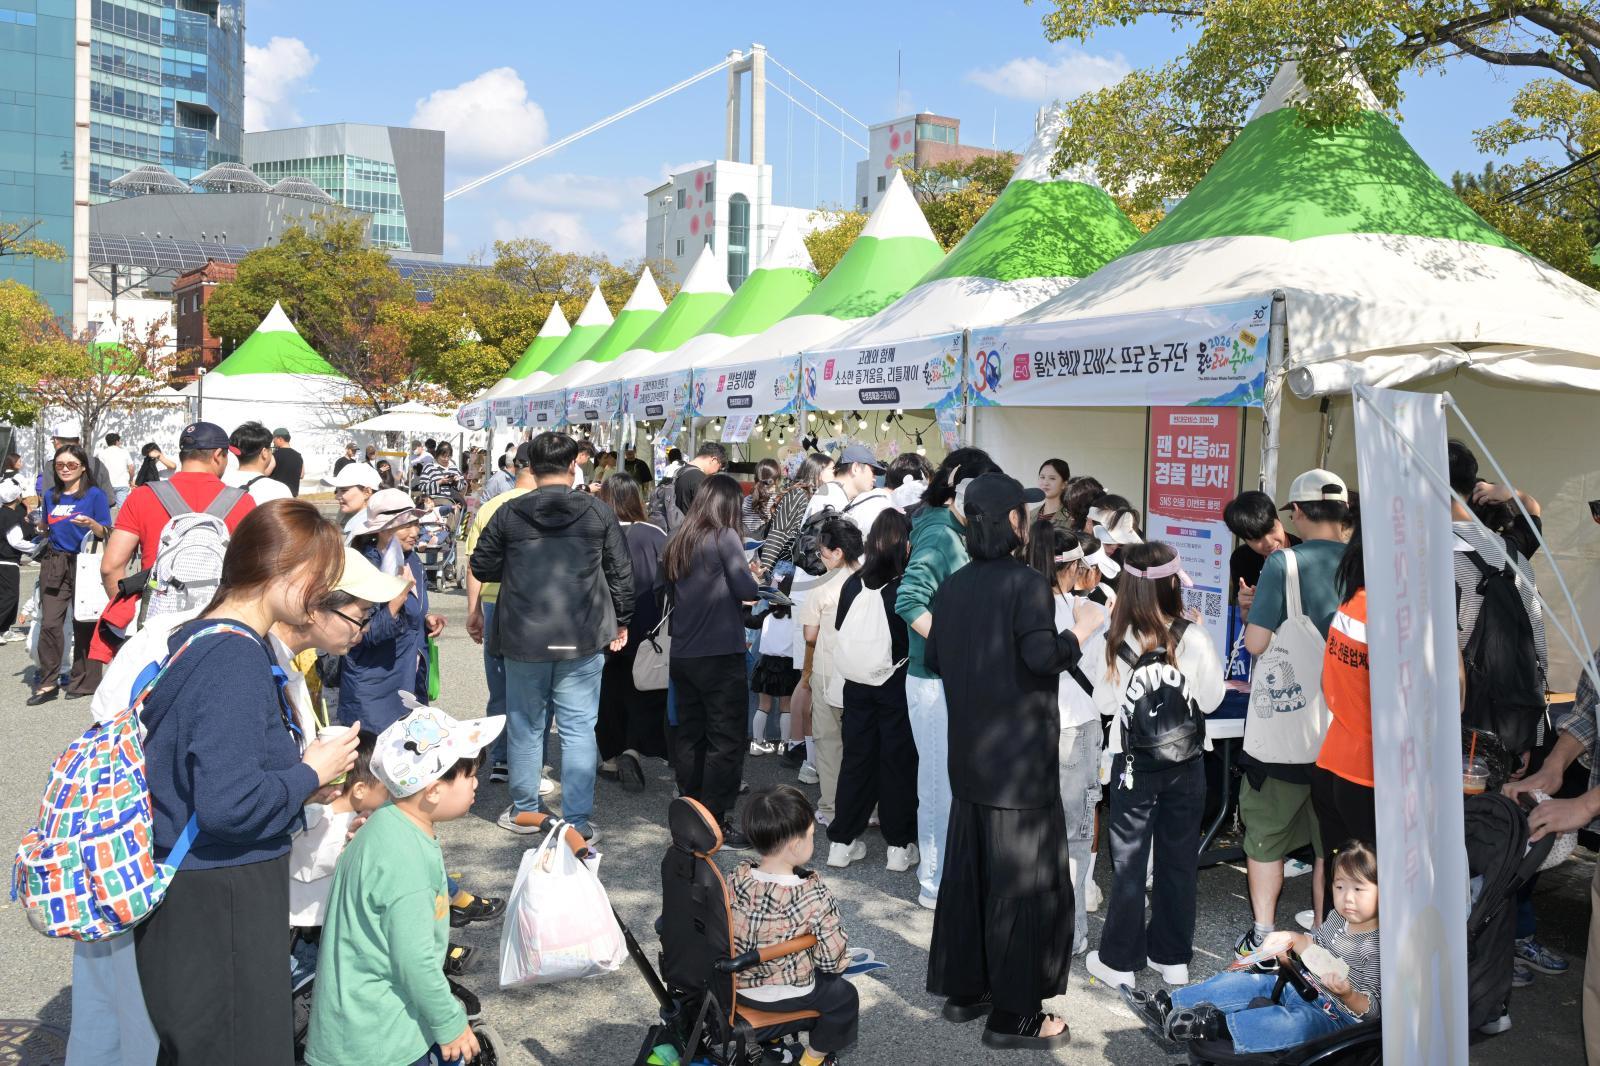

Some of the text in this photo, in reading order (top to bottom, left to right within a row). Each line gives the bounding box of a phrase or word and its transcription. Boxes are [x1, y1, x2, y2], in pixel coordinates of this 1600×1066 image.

[1208, 336, 1231, 348] 2026
[857, 347, 896, 365] 고래와 함께
[1034, 351, 1056, 377] 울산
[1057, 350, 1080, 376] 현대
[1082, 347, 1117, 375] 모비스
[1119, 345, 1146, 373] 프로
[1147, 342, 1188, 374] 농구단
[726, 369, 757, 390] 쌀붕어빵
[834, 364, 919, 385] 소소한 즐거움을, 리틀제이
[1157, 435, 1230, 459] 팬 인증하고
[1155, 462, 1229, 489] 경품 받자!
[51, 504, 76, 516] NIKE
[1159, 496, 1172, 506] SNS
[1172, 497, 1185, 508] 인증
[1186, 498, 1206, 509] 이벤트
